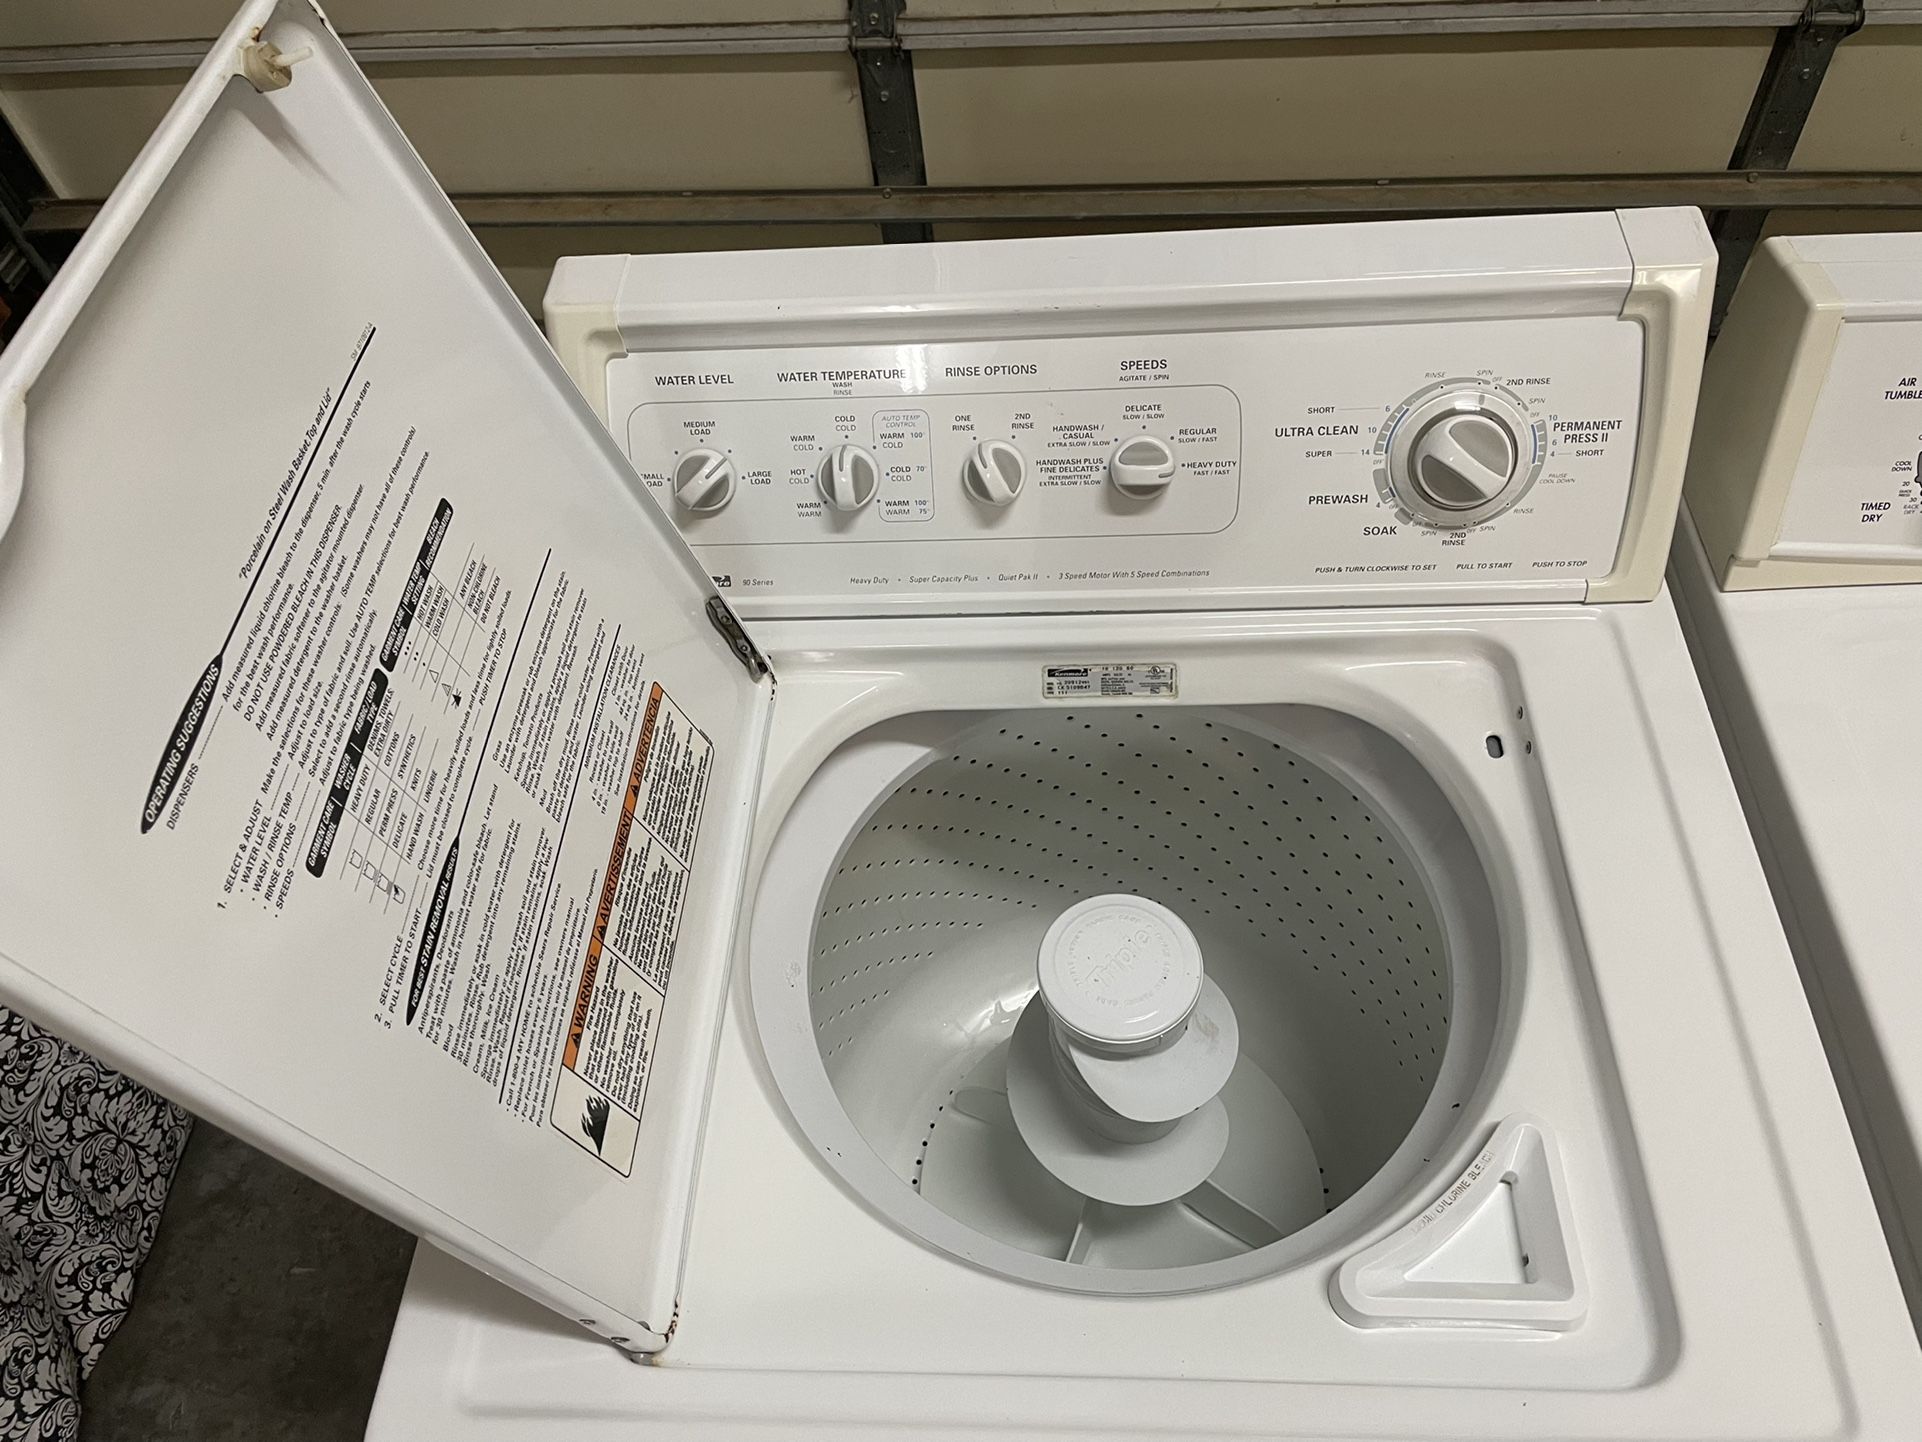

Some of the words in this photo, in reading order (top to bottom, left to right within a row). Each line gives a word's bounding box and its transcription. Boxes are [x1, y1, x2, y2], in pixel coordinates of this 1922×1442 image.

[946, 366, 980, 376] RINSE
[984, 364, 1037, 376] OPTIONS
[1120, 359, 1167, 370] SPEEDS
[655, 376, 696, 386] WATER
[698, 374, 734, 384] LEVEL
[777, 372, 818, 382] WATER
[821, 369, 906, 381] TEMPERATURE
[1898, 378, 1917, 386] AIR
[1125, 404, 1161, 412] DELICATE
[1308, 406, 1335, 414] SHORT
[690, 428, 711, 436] LOAD
[836, 424, 856, 432] COLD
[1053, 424, 1099, 432] HANDWASH
[1275, 427, 1314, 437] ULTRA
[1318, 425, 1358, 436] CLEAN
[1553, 419, 1622, 432] PERMANENT
[1063, 432, 1094, 440] CASUAL
[1564, 433, 1598, 444] PRESS
[1601, 432, 1608, 442] II
[1306, 450, 1332, 458] SUPER
[1036, 458, 1082, 466] HANDWASH
[1059, 464, 1100, 473] DELICATES
[264, 520, 272, 534] on
[269, 492, 284, 520] Steel
[280, 470, 296, 495] Wash
[316, 406, 325, 426] and
[1309, 494, 1368, 504] PREWASH
[1861, 502, 1891, 510] TIMED
[1862, 514, 1883, 522] DRY
[1363, 526, 1397, 536] SOAK
[873, 576, 889, 584] Duty
[909, 576, 930, 584] Super
[932, 575, 962, 583] Capacity
[1059, 572, 1063, 580] 3
[1064, 572, 1087, 580] Speed
[1136, 570, 1160, 578] Speed
[752, 578, 773, 586] Series
[144, 750, 181, 822] OPERATING
[176, 662, 218, 750] SUGGESTIONS
[634, 695, 659, 782] ADVERTENCIA
[350, 785, 363, 812] HEAVY
[359, 764, 370, 786] DUTY
[166, 763, 198, 830] DISPENSERS
[278, 792, 292, 819] TEMP
[365, 788, 381, 825] REGULAR
[379, 814, 390, 837] PERM
[385, 788, 398, 814] PRESS
[267, 820, 283, 852] RINSE
[224, 852, 243, 894] SELECT
[239, 844, 247, 852] &
[243, 799, 262, 842] ADJUST
[241, 846, 260, 883] WATER
[255, 816, 272, 846] LEVEL
[264, 868, 280, 901] RINSE
[276, 823, 296, 868] OPTIONS
[265, 852, 272, 860] /
[600, 810, 633, 924] AVERTISSEMENT
[252, 859, 269, 892] WASH
[276, 868, 294, 910] SPEEDS
[409, 908, 421, 939] START
[412, 988, 420, 1007] FOR
[416, 966, 425, 989] BEST
[421, 931, 435, 967] STAIN
[430, 881, 449, 932] REMOVAL
[445, 846, 460, 881] RESULTS
[404, 940, 412, 953] TO
[396, 956, 408, 985] TIMER
[374, 1010, 383, 1022] 2.
[380, 967, 394, 1006] SELECT
[390, 936, 403, 966] CYCLE
[574, 954, 598, 1028] WARNING
[388, 990, 400, 1014] PULL
[384, 1016, 393, 1029] 3.
